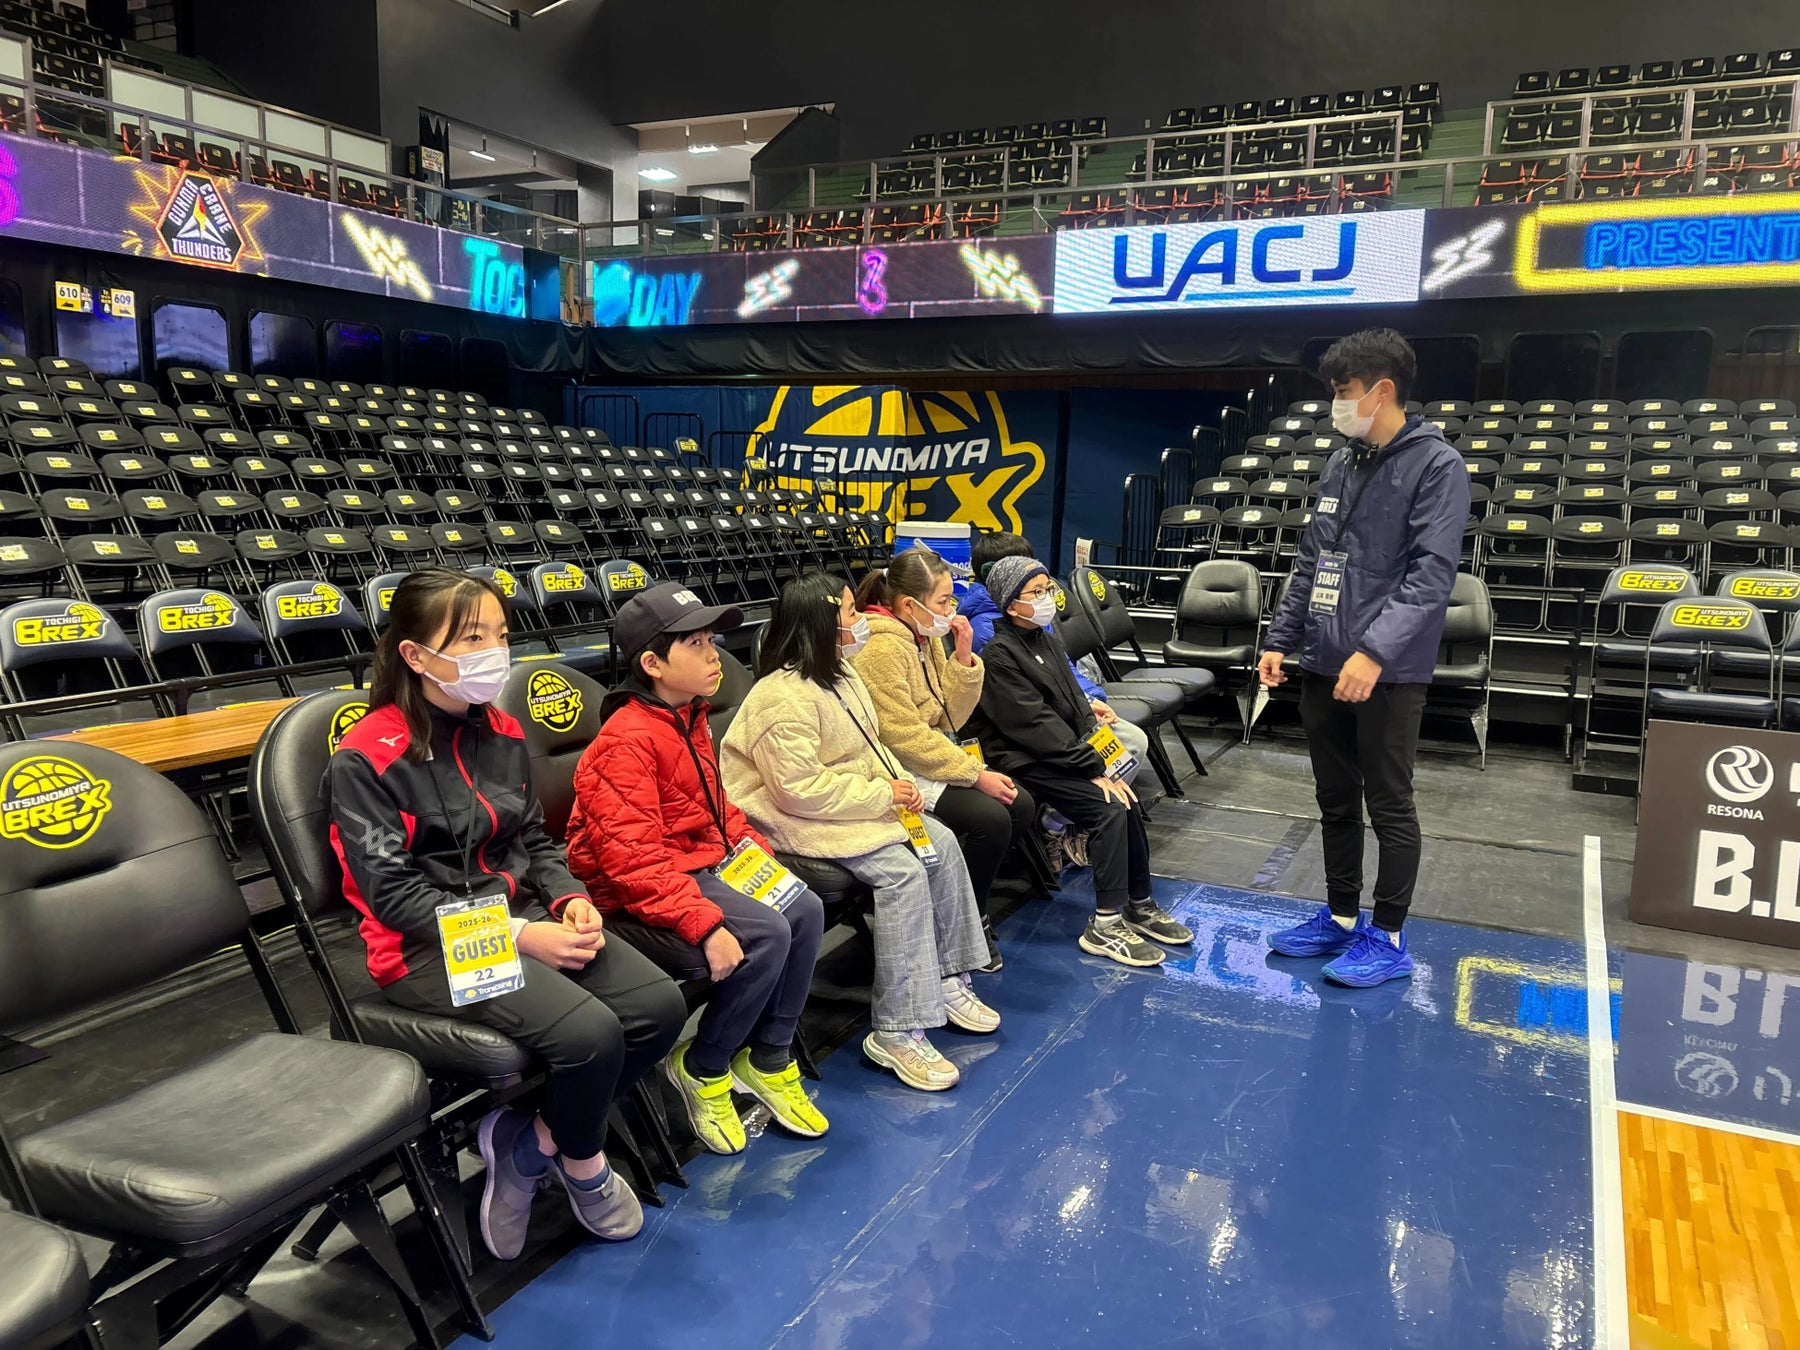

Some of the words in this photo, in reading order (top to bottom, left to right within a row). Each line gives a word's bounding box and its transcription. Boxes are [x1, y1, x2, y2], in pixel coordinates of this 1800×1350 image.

[168, 178, 199, 226] GUNMA
[199, 183, 233, 234] CRANE
[171, 238, 232, 263] THUNDERS
[1111, 222, 1358, 304] UACJ
[59, 286, 78, 299] 610
[114, 294, 132, 305] 609
[629, 272, 703, 326] DAY
[543, 574, 584, 590] BREX
[609, 574, 646, 591] BREX
[1317, 571, 1341, 586] STAFF
[1620, 573, 1681, 590] BREX
[1733, 579, 1795, 597] BREX
[278, 597, 338, 618] BREX
[297, 595, 323, 603] TOCHIGI
[184, 605, 215, 614] TOCHIGI
[1674, 607, 1743, 627] BREX
[45, 616, 81, 626] TOCHIGI
[159, 607, 232, 632] BREX
[15, 619, 101, 645] BREX
[532, 693, 580, 718] BREX
[1100, 739, 1120, 760] UEST
[2, 781, 91, 812] UTSUNOMIYA
[4, 785, 105, 832] BREX
[1707, 804, 1764, 821] RESONA
[908, 825, 927, 840] GUEST
[742, 861, 778, 896] GUEST
[767, 886, 782, 900] 21
[458, 916, 491, 928] 2025-26
[452, 934, 508, 963] GUEST
[474, 968, 495, 982] 22
